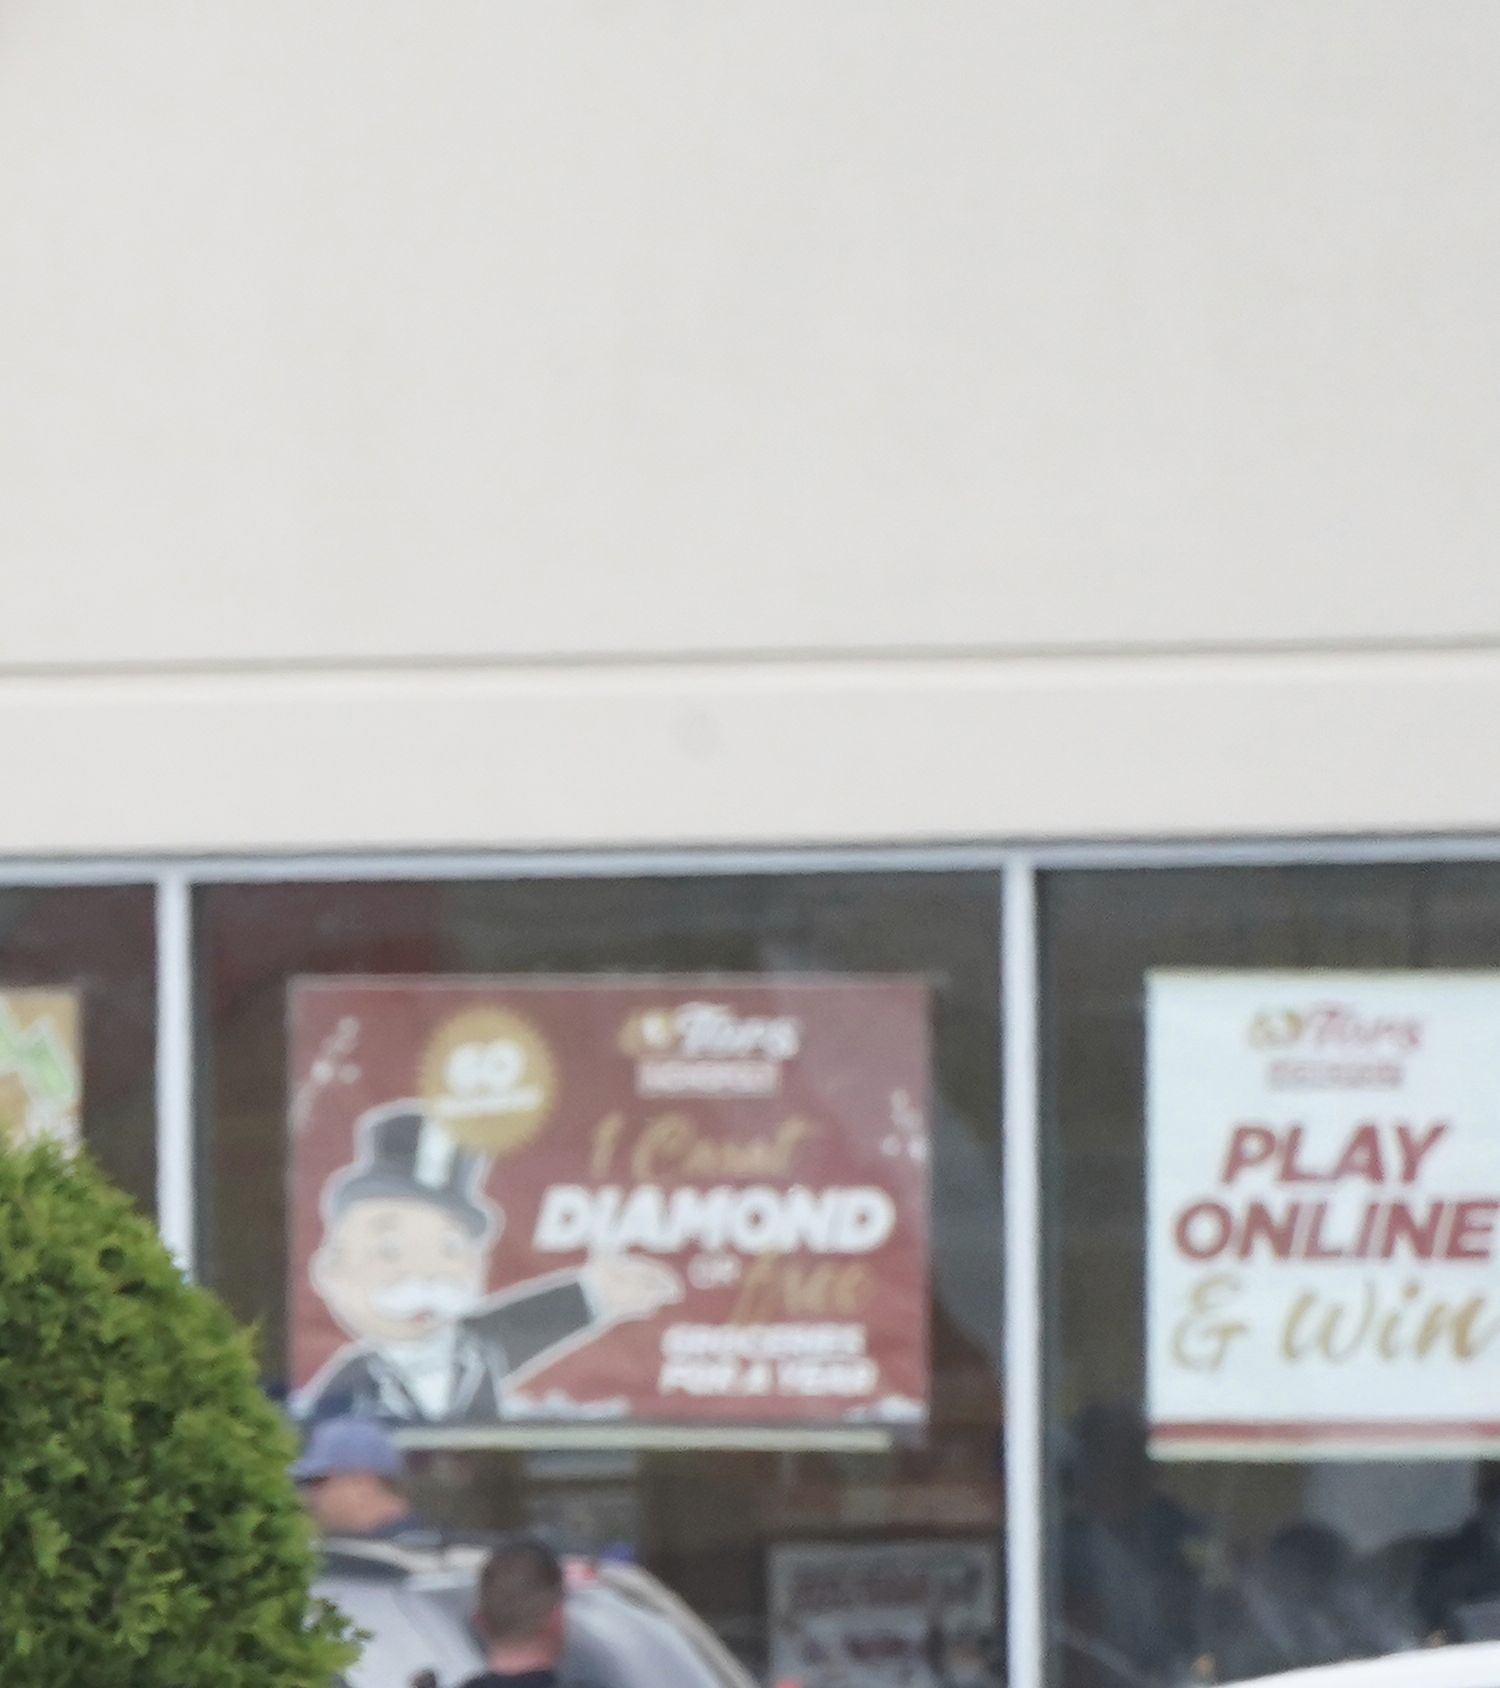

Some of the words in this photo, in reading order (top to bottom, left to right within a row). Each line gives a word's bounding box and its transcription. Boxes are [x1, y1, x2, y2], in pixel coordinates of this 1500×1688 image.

[1222, 1123, 1452, 1184] PLAY
[534, 1182, 896, 1253] DIAMOND
[1173, 1198, 1500, 1262] ONLINE
